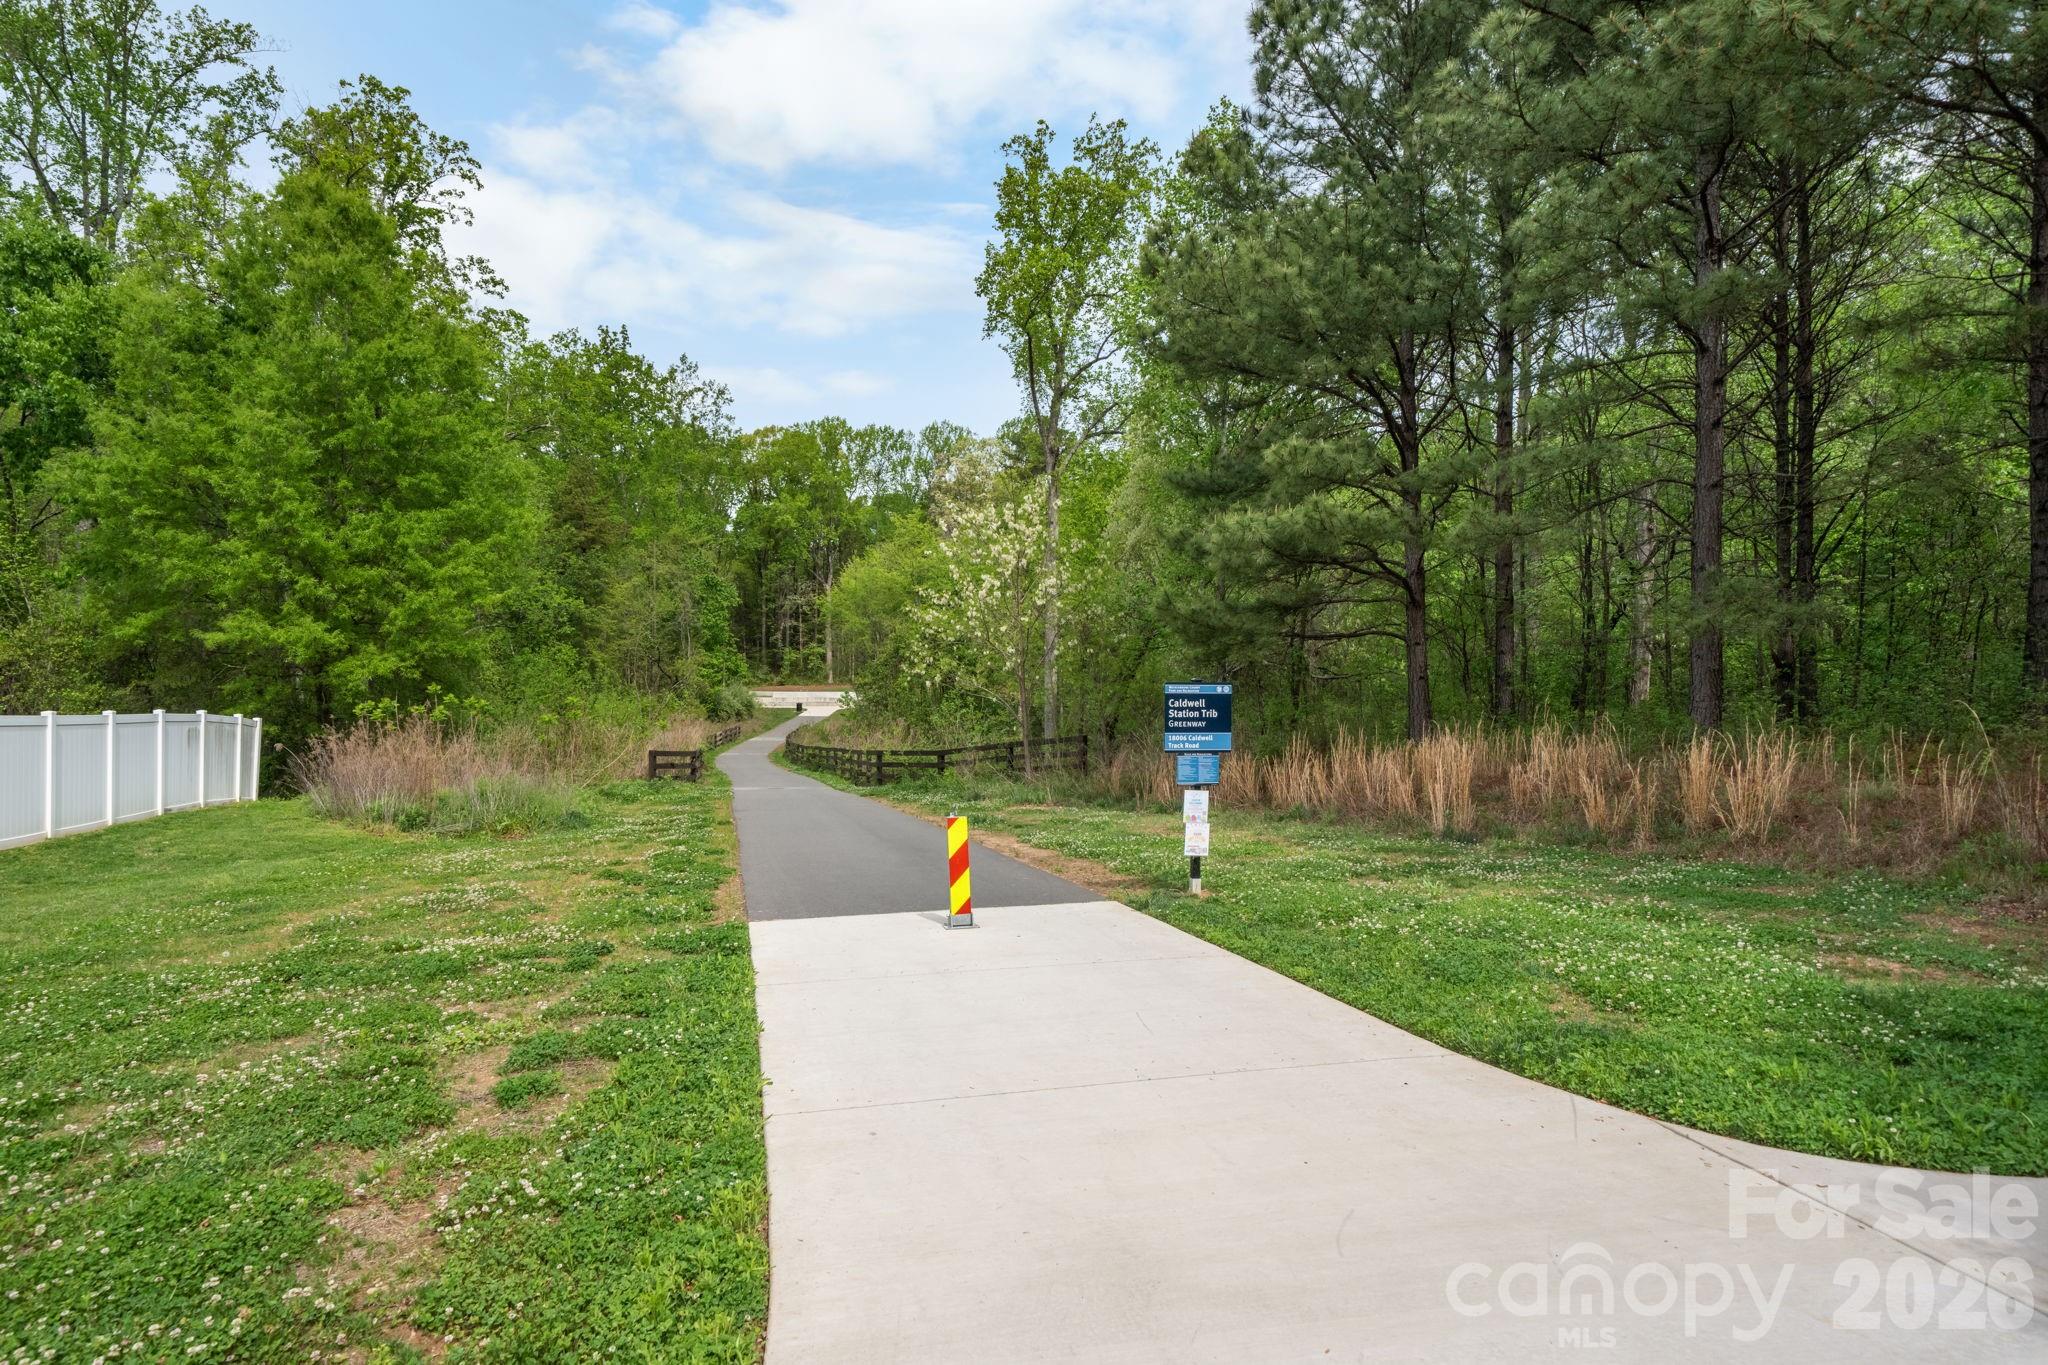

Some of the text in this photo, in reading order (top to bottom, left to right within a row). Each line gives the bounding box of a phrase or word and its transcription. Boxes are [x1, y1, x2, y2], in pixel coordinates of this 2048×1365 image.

[1168, 699, 1206, 708] Caldwell
[1168, 709, 1218, 718] Station Trib
